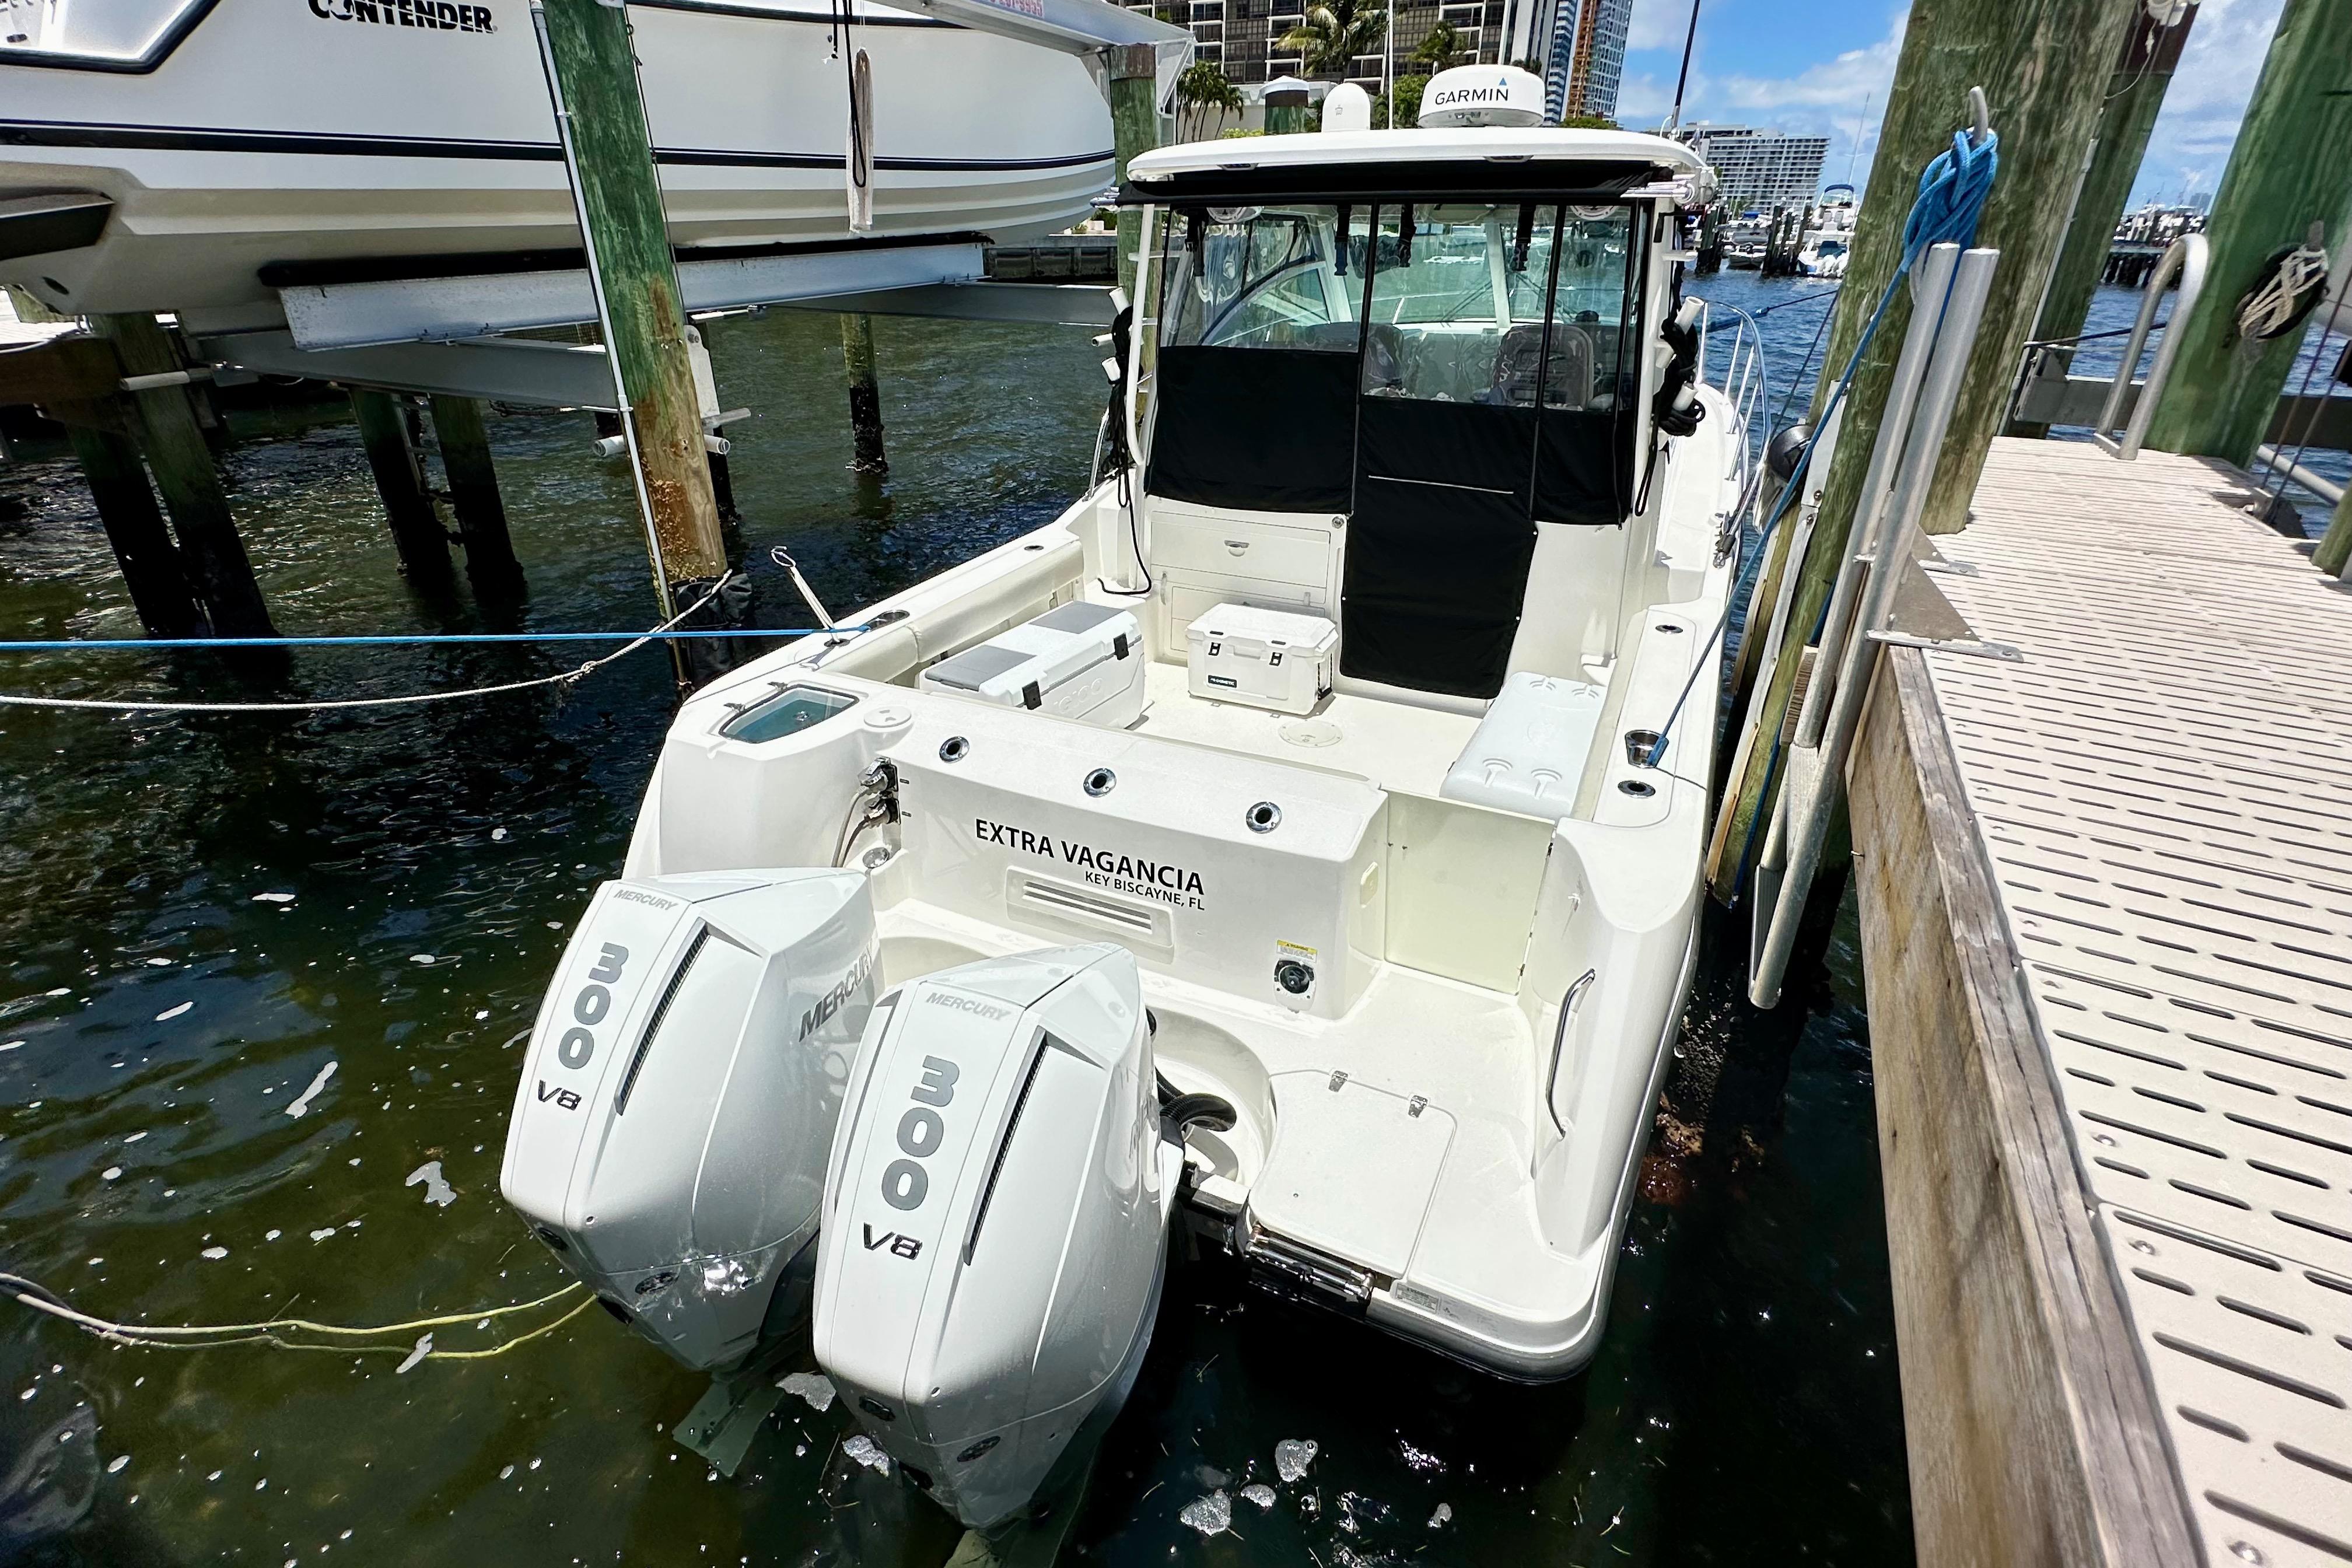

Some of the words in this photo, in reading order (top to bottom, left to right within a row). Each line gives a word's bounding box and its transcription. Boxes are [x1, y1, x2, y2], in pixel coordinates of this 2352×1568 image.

[309, 0, 494, 34] CONTENDER
[1435, 89, 1508, 105] GARMIN
[976, 818, 1054, 858] EXTRA
[1060, 840, 1205, 895] VAGANCIA
[614, 890, 678, 911] MERCURY
[1085, 871, 1110, 887] KEY
[1114, 878, 1185, 907] BISCAYNE,
[1188, 897, 1205, 911] FL
[558, 942, 629, 1070] 300
[799, 938, 873, 1042] MERCURY
[925, 992, 1011, 1021] MERCURY
[538, 1079, 582, 1111] V8
[881, 1055, 960, 1211] 300
[863, 1222, 923, 1260] V8
